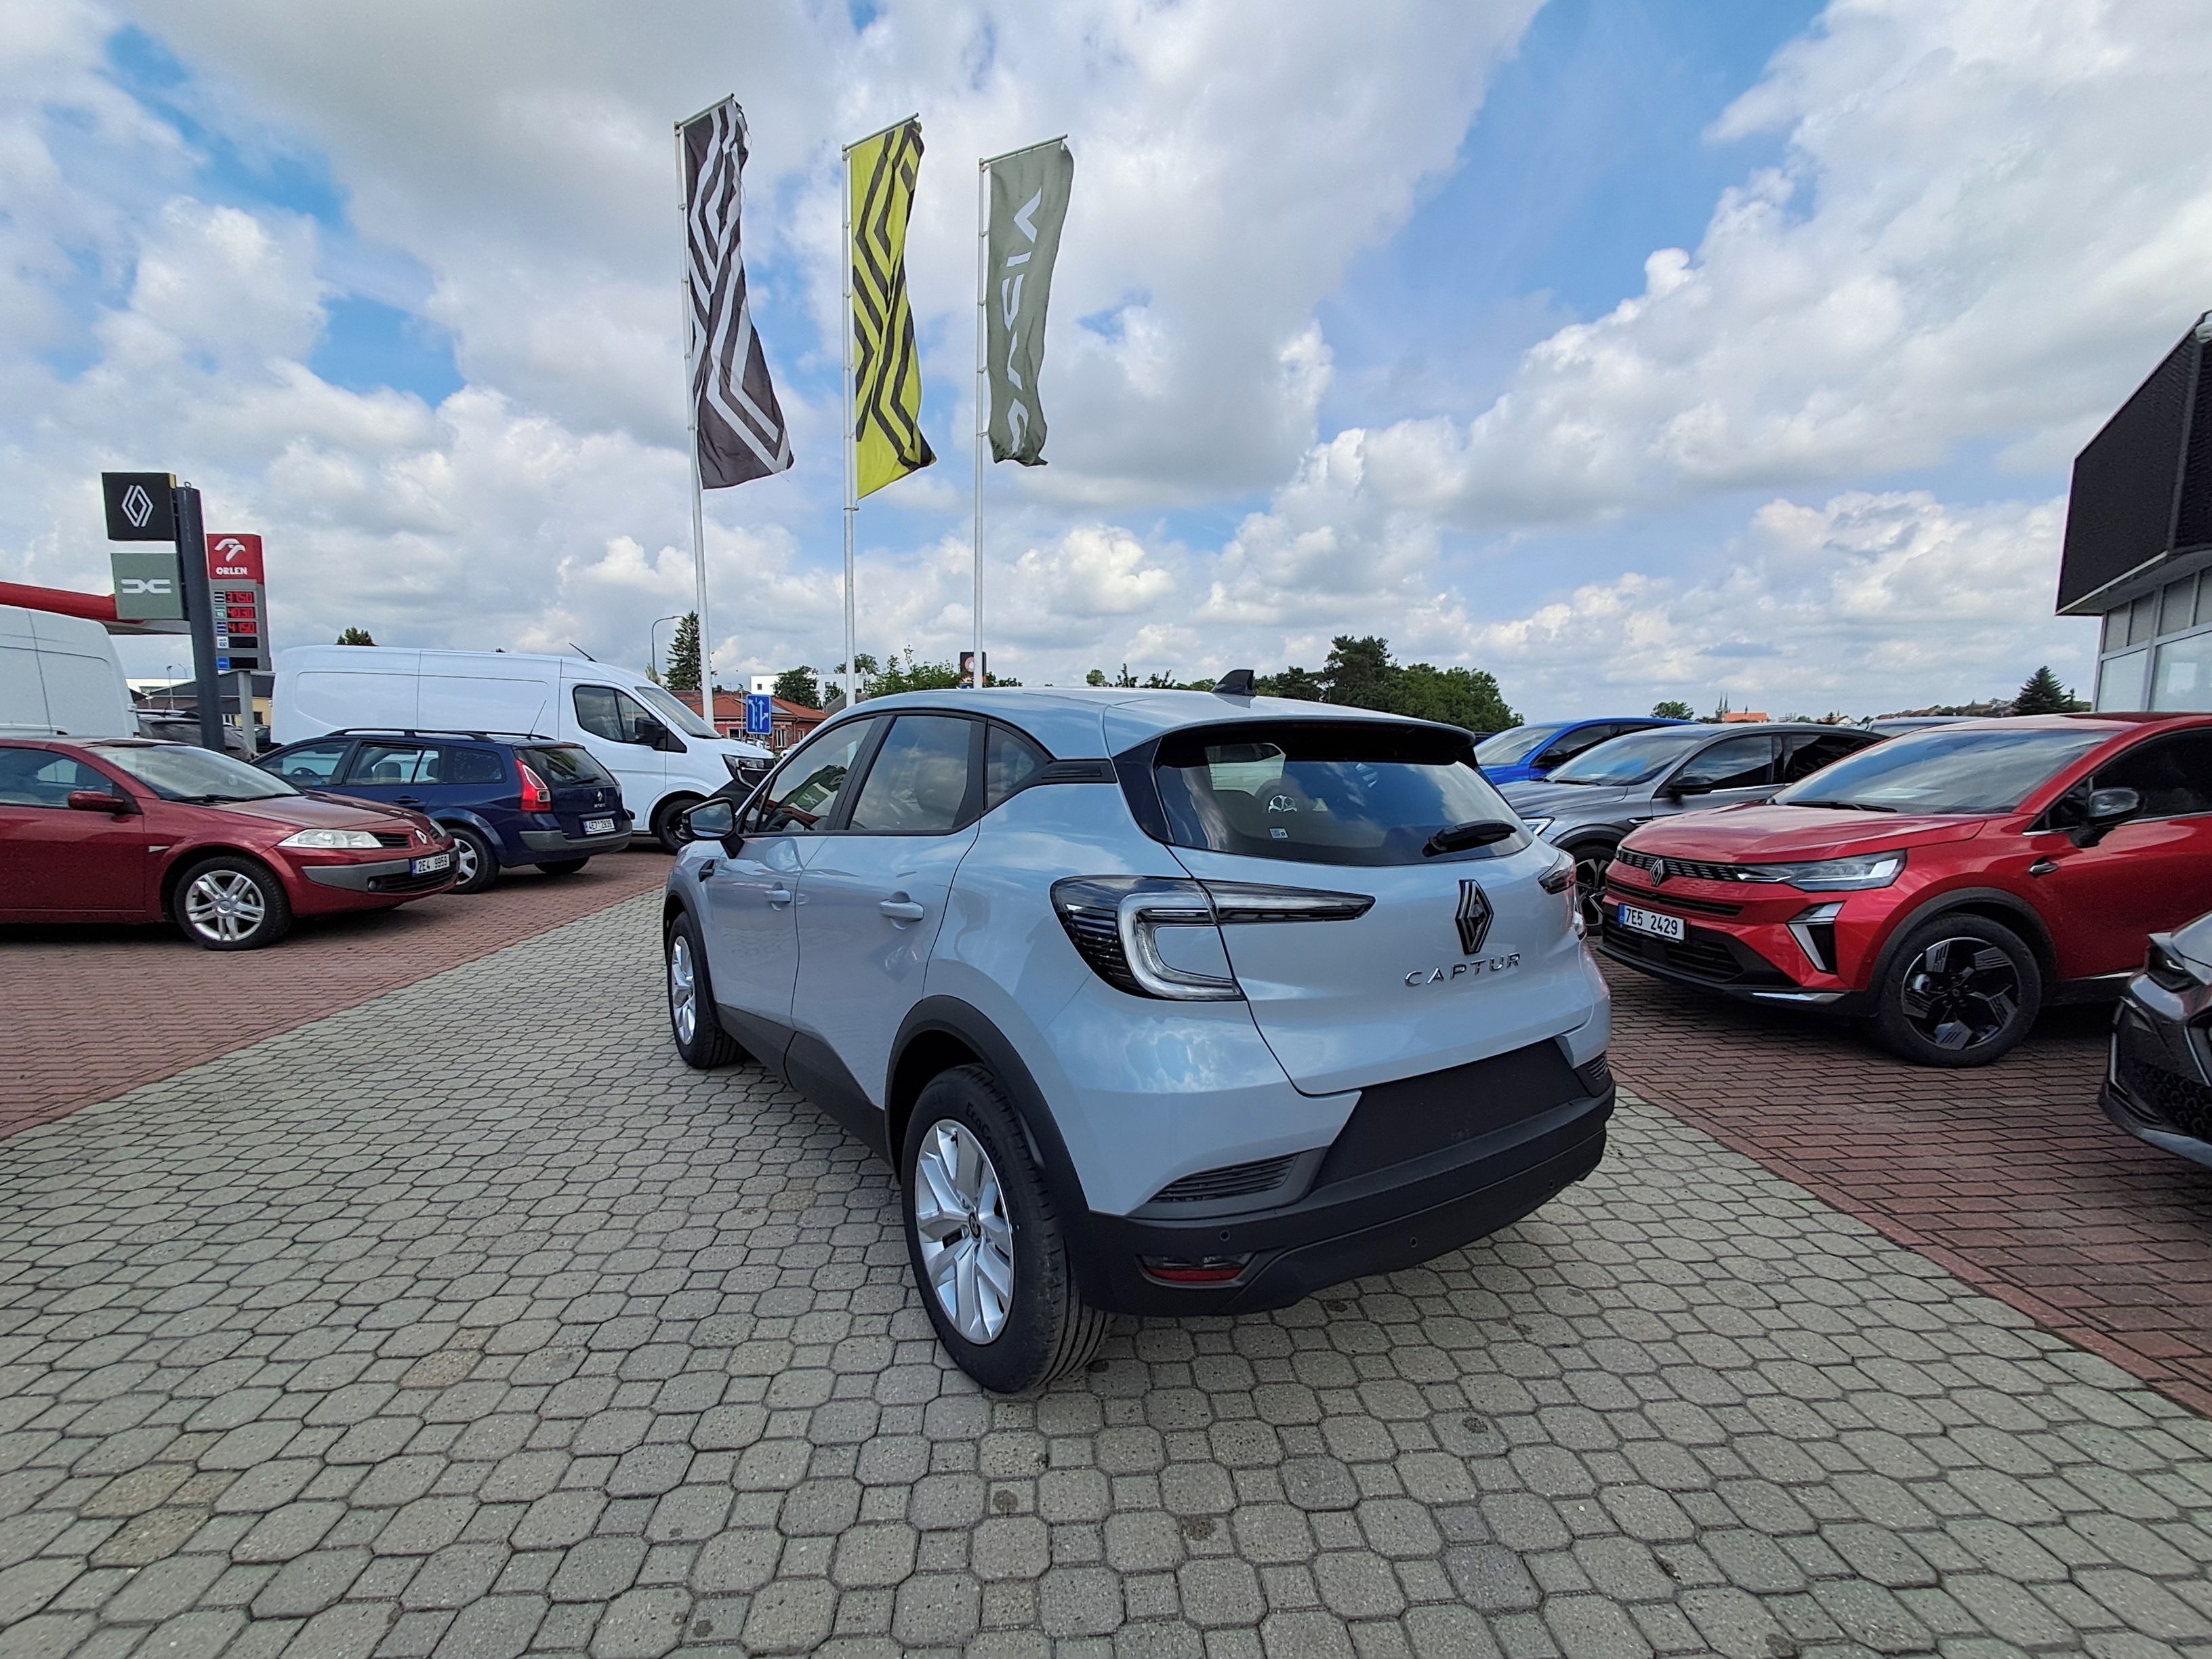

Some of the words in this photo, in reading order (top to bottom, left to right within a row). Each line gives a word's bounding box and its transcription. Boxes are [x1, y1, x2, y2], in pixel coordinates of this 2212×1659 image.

[216, 567, 248, 575] ORLEN
[418, 859, 430, 872] 2E4
[1626, 908, 1643, 926] 7E5
[1650, 915, 1678, 935] 2429
[1404, 952, 1521, 987] CAPTUR
